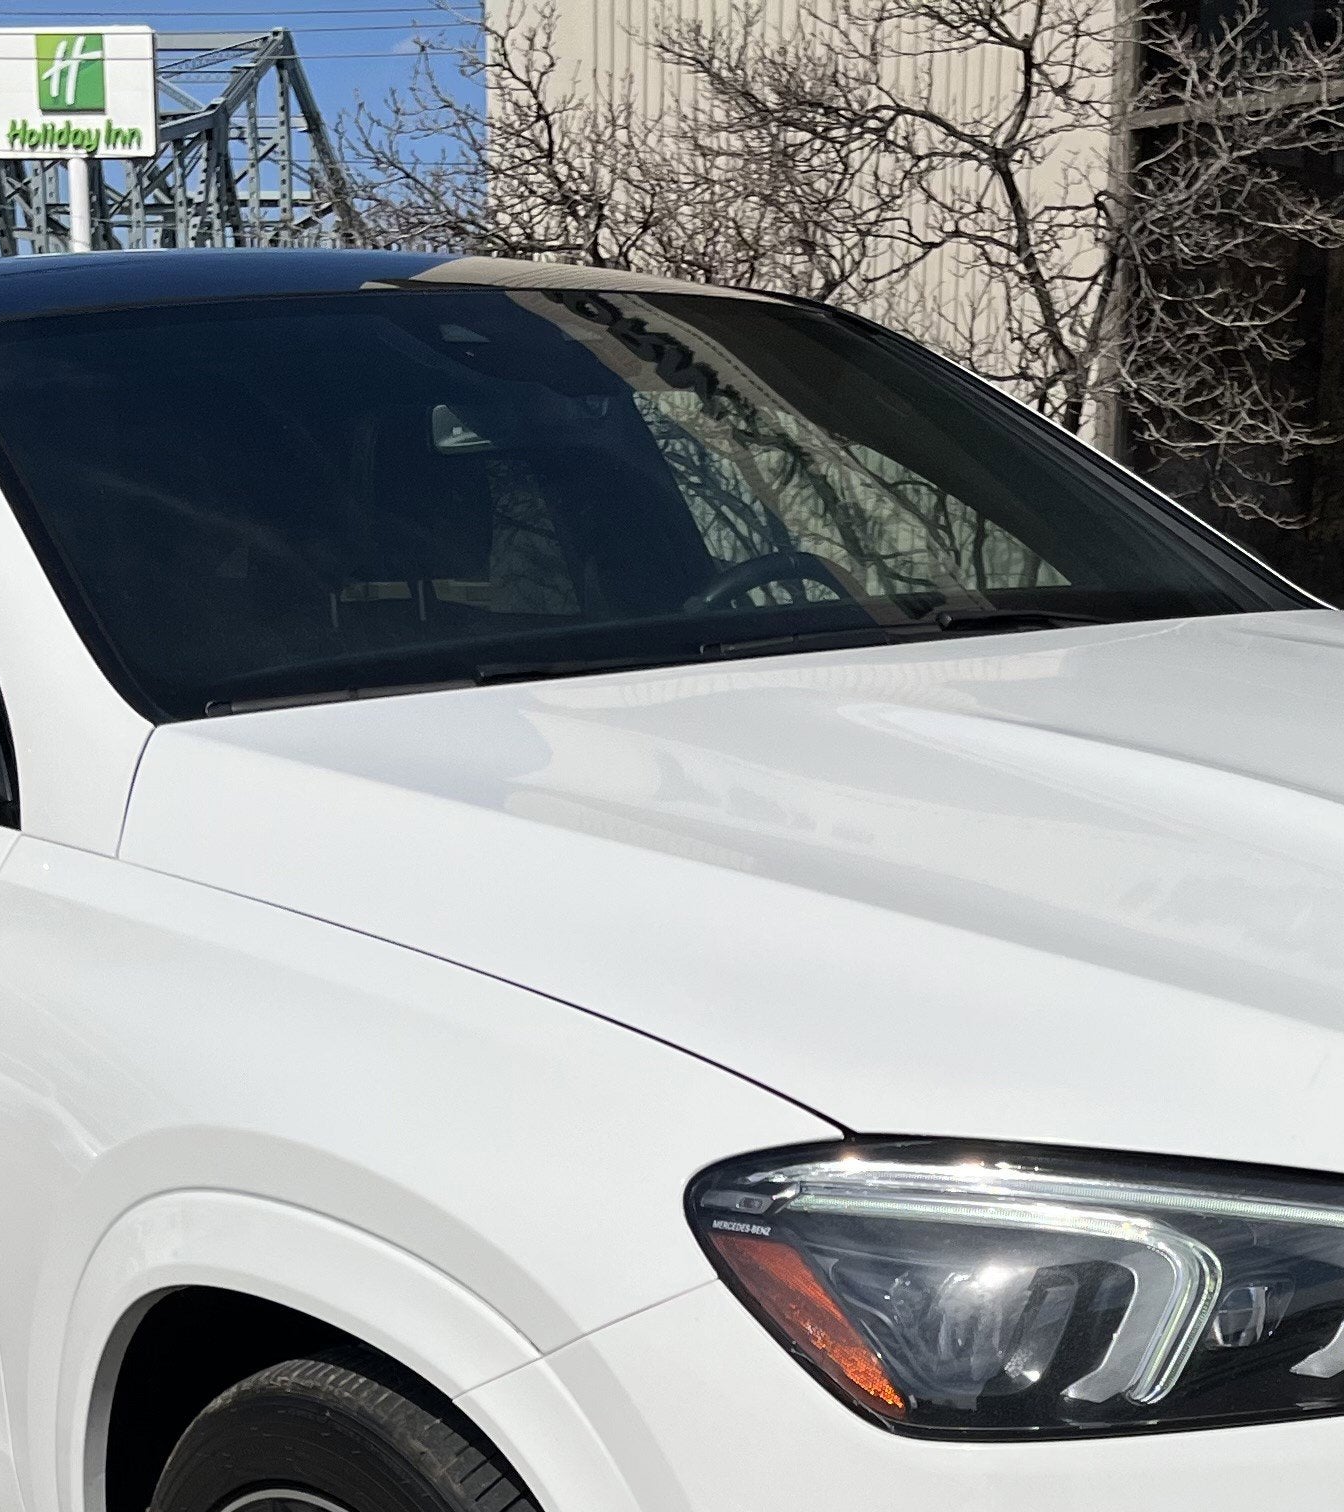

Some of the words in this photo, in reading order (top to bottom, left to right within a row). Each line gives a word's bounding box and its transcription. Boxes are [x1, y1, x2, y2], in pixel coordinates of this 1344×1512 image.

[7, 119, 100, 153] Holiday
[105, 119, 142, 149] Inn
[712, 1219, 772, 1237] MERCEDES-BENZ
